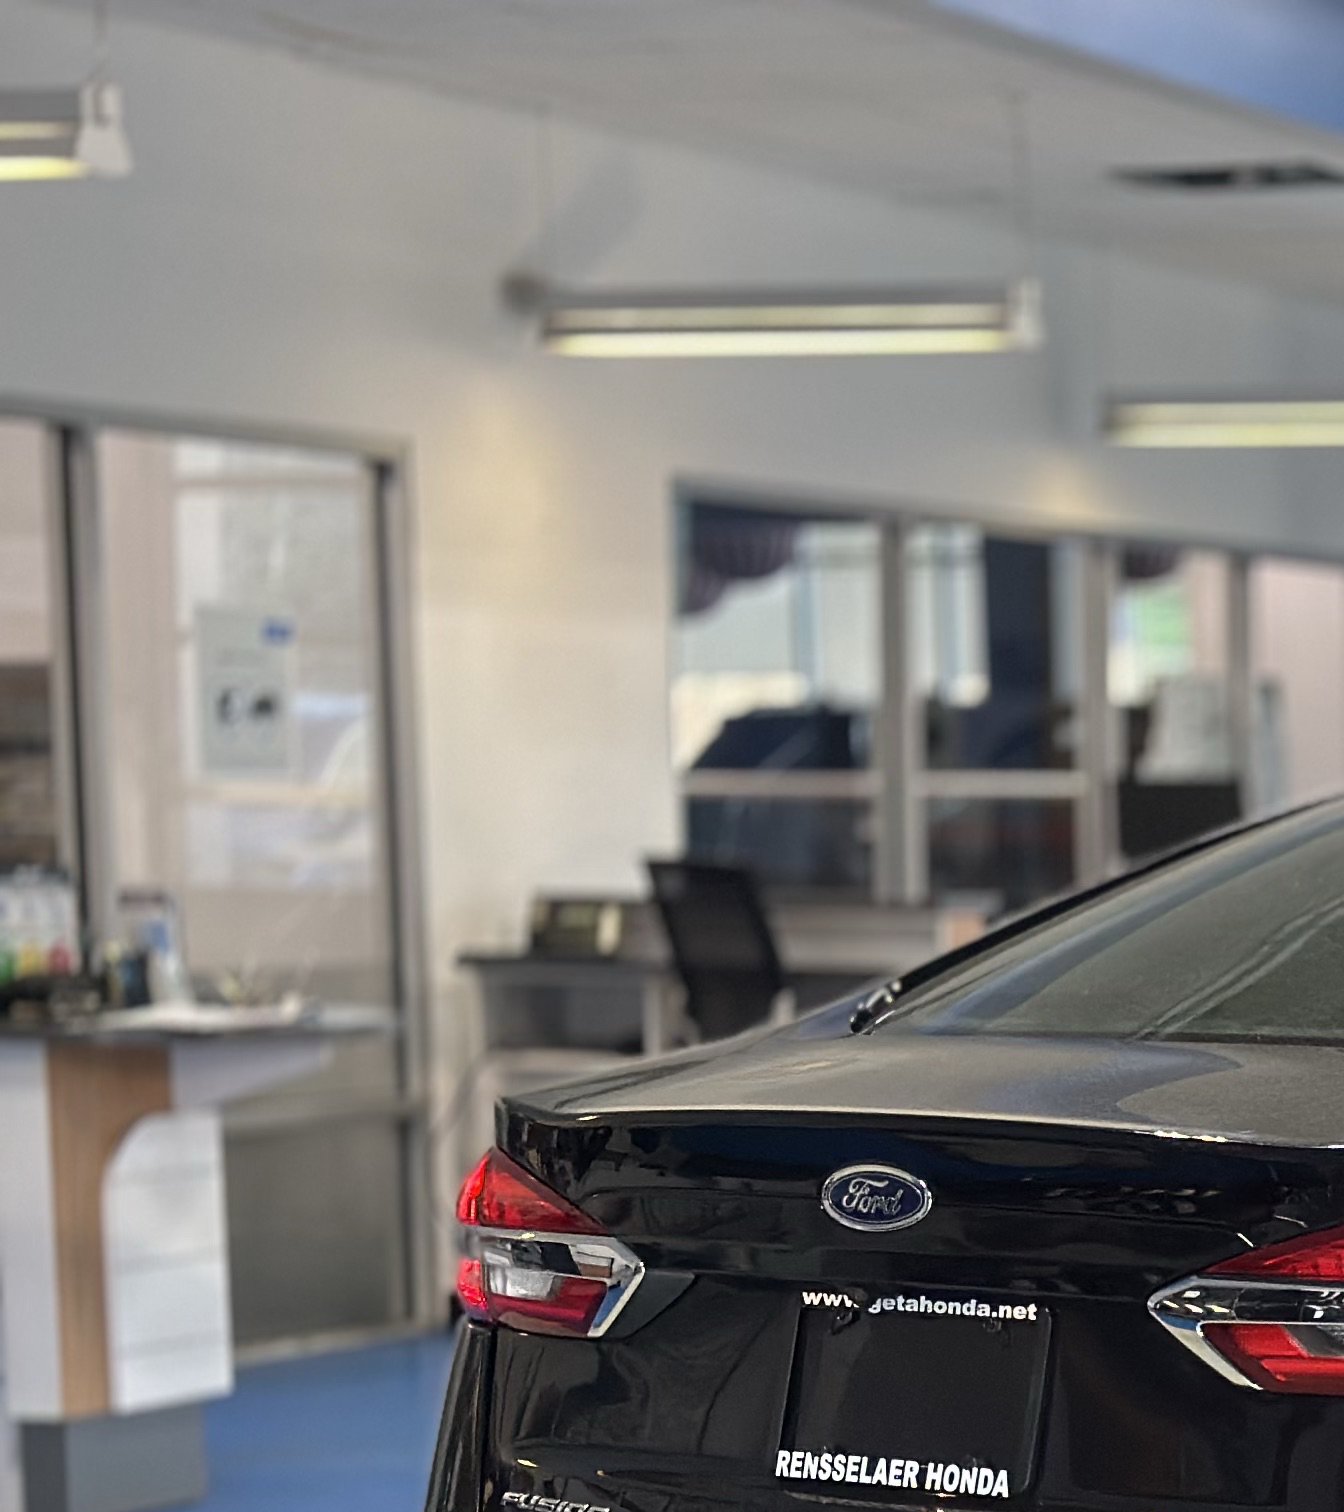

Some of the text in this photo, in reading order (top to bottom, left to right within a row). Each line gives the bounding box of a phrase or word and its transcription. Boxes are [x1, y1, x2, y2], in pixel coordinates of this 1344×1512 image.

[842, 1178, 904, 1215] Ford
[802, 1291, 1037, 1320] wwwgetahonda.net
[775, 1450, 1009, 1497] RENSSELAER HONDA
